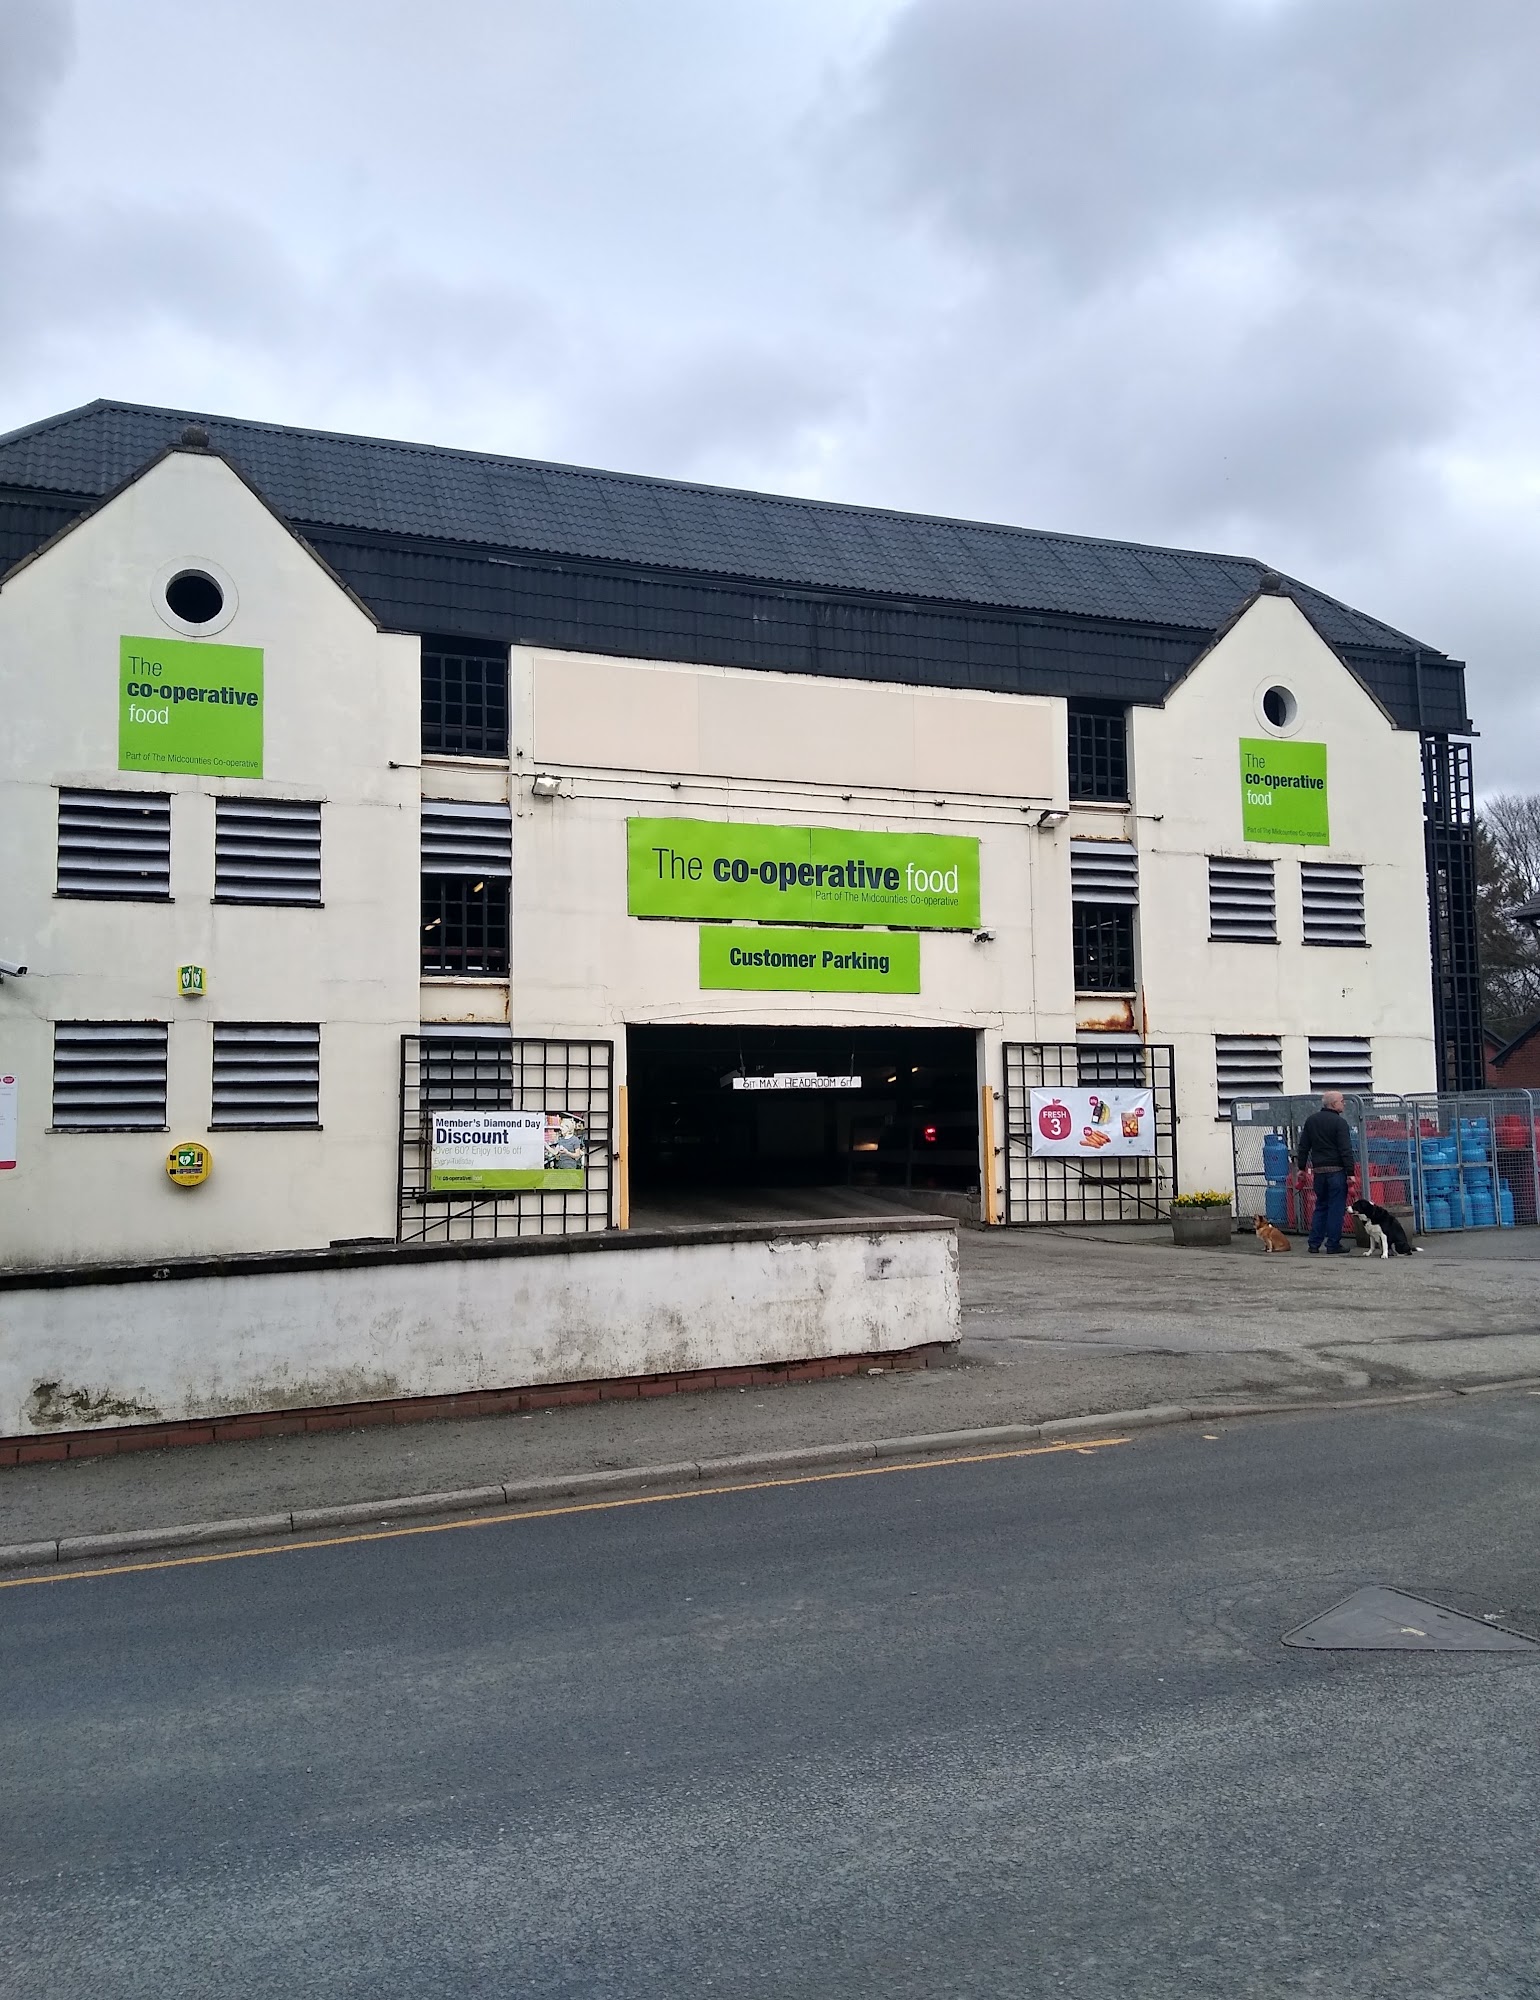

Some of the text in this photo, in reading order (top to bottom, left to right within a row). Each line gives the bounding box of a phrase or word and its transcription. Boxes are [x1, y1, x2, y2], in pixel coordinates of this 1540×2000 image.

[128, 656, 162, 677] The
[127, 682, 259, 707] co-operative
[128, 703, 169, 725] food
[126, 752, 259, 769] Part of The Midcounties Co-operative
[1245, 753, 1266, 769] The
[1245, 773, 1324, 790] co-operative
[1247, 789, 1272, 806] food
[652, 847, 959, 894] The co-operative food
[815, 890, 959, 907] Part of The Midcounties Co-operative
[730, 947, 890, 974] Customer Parking
[759, 1079, 779, 1088] MAX
[784, 1077, 836, 1088] HEADROOM
[1042, 1111, 1067, 1119] FRESH
[435, 1118, 541, 1130] Member's Diamond Day
[1050, 1118, 1061, 1136] 3
[436, 1128, 509, 1145] Discount
[435, 1146, 522, 1157] Over 60? Enjoy 10% off
